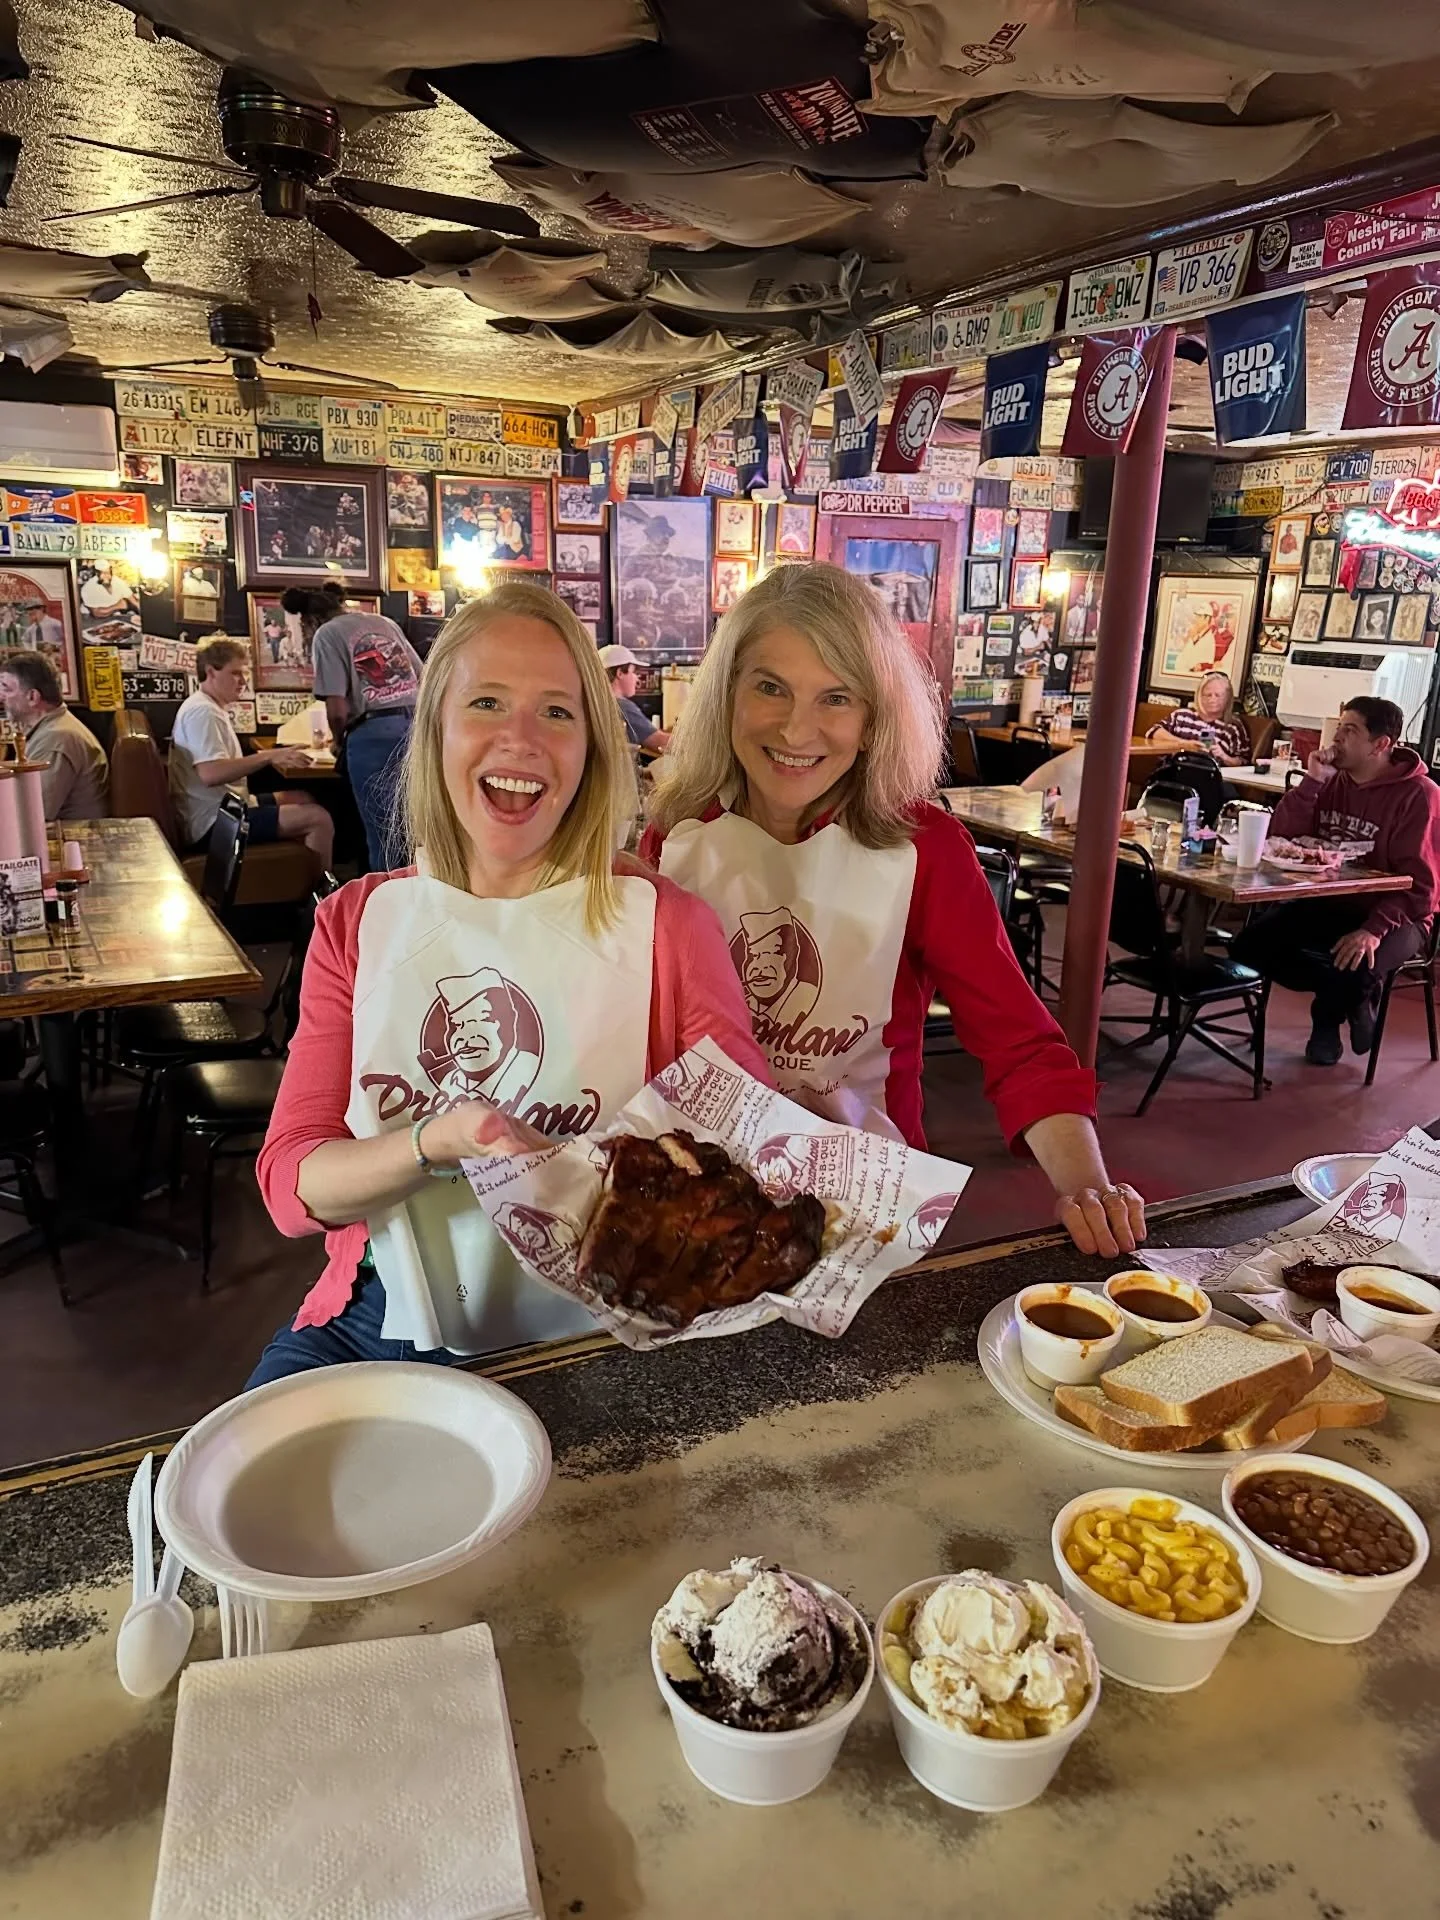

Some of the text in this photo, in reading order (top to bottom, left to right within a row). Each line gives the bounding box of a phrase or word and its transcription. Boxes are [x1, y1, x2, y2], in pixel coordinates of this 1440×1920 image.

[988, 23, 1023, 46] TIDE
[797, 80, 863, 143] YOUNGLIFE
[1347, 212, 1406, 244] Neshoba
[1337, 236, 1385, 261] County
[1390, 223, 1418, 242] Fair
[1179, 249, 1239, 296] VB 366
[1083, 311, 1125, 328] SARASOTA
[1376, 289, 1437, 339] CRIMSON
[966, 316, 990, 348] BM9
[1093, 350, 1131, 387] CRIMSON
[1223, 342, 1275, 379] BUD
[1371, 347, 1397, 400] SPORTS
[1215, 363, 1287, 406] LIGHT
[122, 392, 183, 411] 26-A3315
[190, 396, 209, 414] EM
[991, 383, 1026, 408] BUD
[295, 402, 319, 419] RGE
[327, 407, 378, 427] PBX 930
[391, 409, 414, 426] PRA
[984, 401, 1032, 431] LIGHT
[1088, 393, 1107, 436] SPORTS
[449, 413, 500, 429] PIEDMONT
[197, 430, 253, 450] ELEFNT
[736, 435, 758, 453] BUD
[833, 432, 869, 454] LIGHT
[389, 445, 444, 463] CNJ 480
[449, 447, 501, 467] NTJ 847
[1255, 467, 1271, 482] 941
[1349, 458, 1368, 475] 700
[847, 494, 862, 512] DR
[864, 494, 904, 513] PEPPER
[1035, 488, 1050, 502] 447
[1404, 491, 1435, 511] BBQ
[29, 524, 65, 533] VIRGINIA
[59, 535, 75, 551] 79
[153, 678, 185, 693] 3878
[0, 859, 38, 871] TAILGATE
[20, 915, 40, 923] NOW
[768, 1055, 812, 1071] QUE
[358, 1072, 602, 1137] Dreamland
